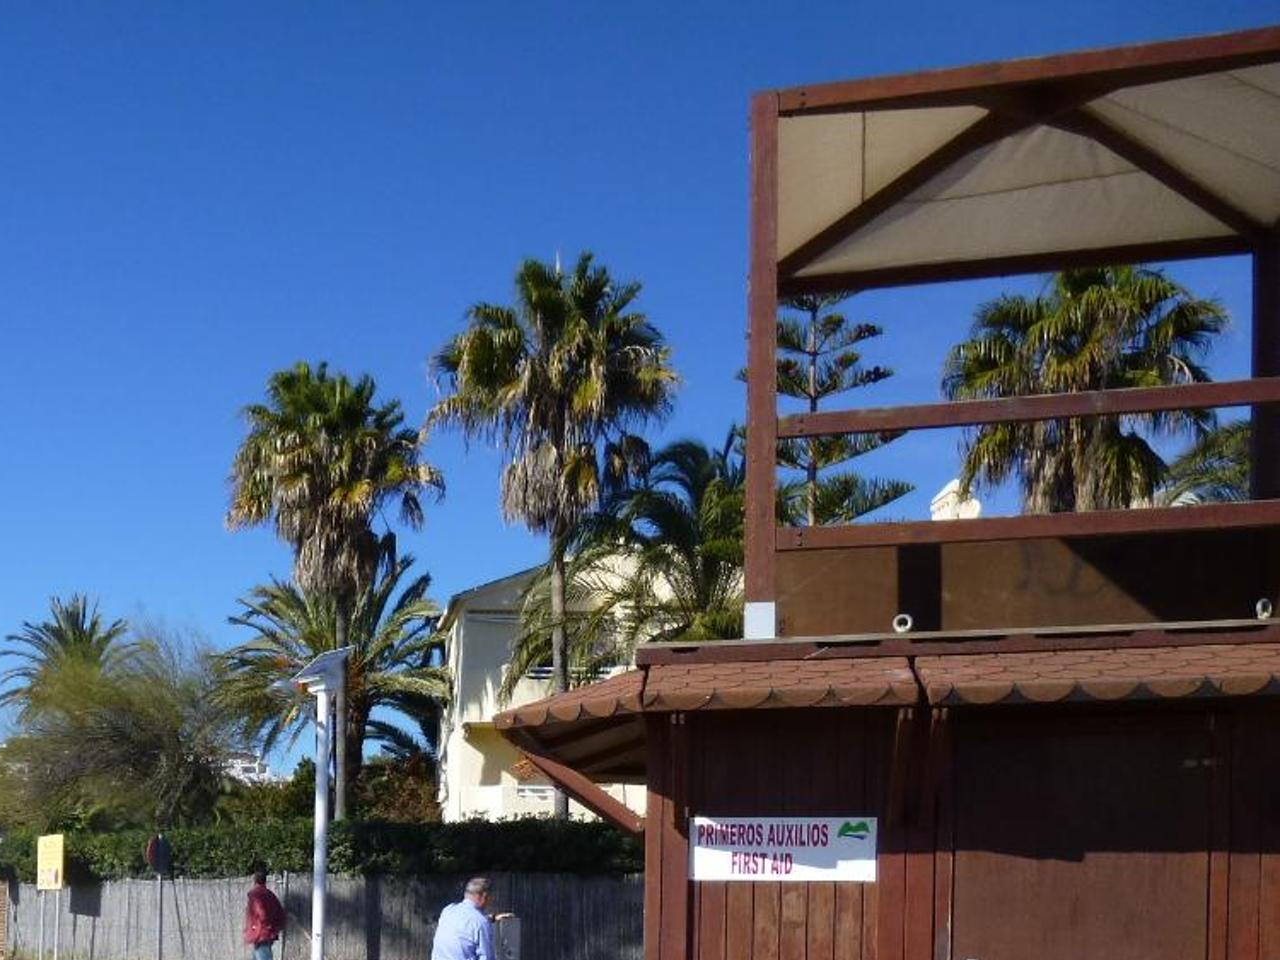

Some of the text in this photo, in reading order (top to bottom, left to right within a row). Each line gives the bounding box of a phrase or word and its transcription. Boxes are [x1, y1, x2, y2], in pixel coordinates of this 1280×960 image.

[698, 824, 829, 847] PRIMEROS AUXILIOS
[731, 852, 793, 874] FIRST AID
